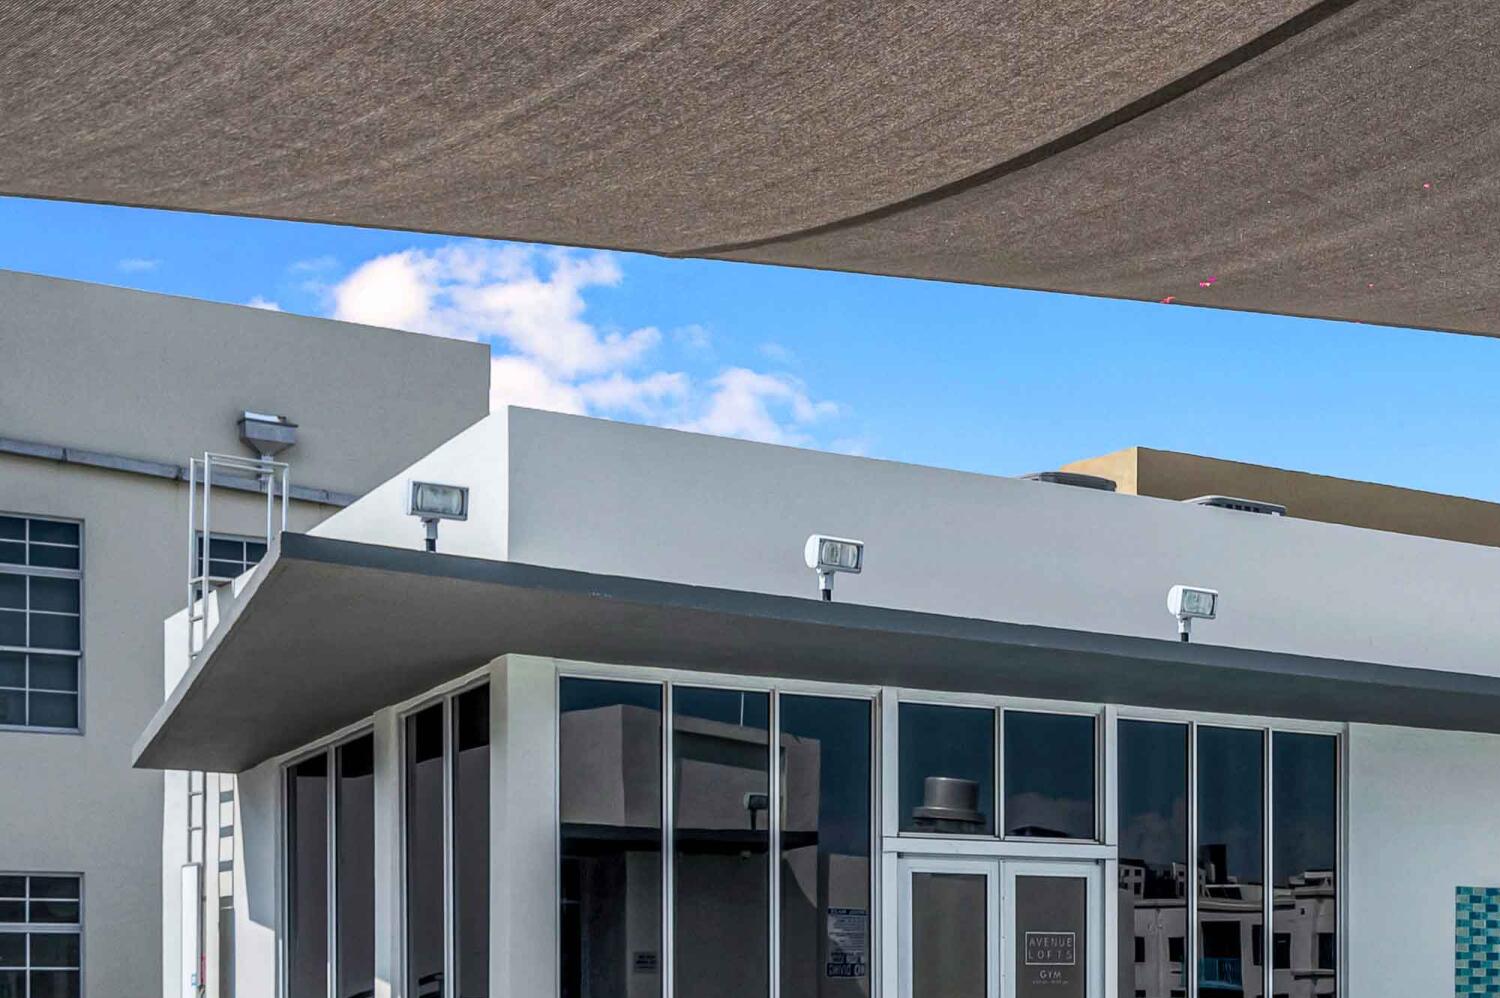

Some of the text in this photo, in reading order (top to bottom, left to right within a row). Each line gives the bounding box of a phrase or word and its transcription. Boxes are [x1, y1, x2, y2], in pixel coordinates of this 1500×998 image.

[1029, 936, 1073, 948] AVENUE
[1028, 949, 1073, 960] LOFTS
[1039, 969, 1062, 979] GYM
